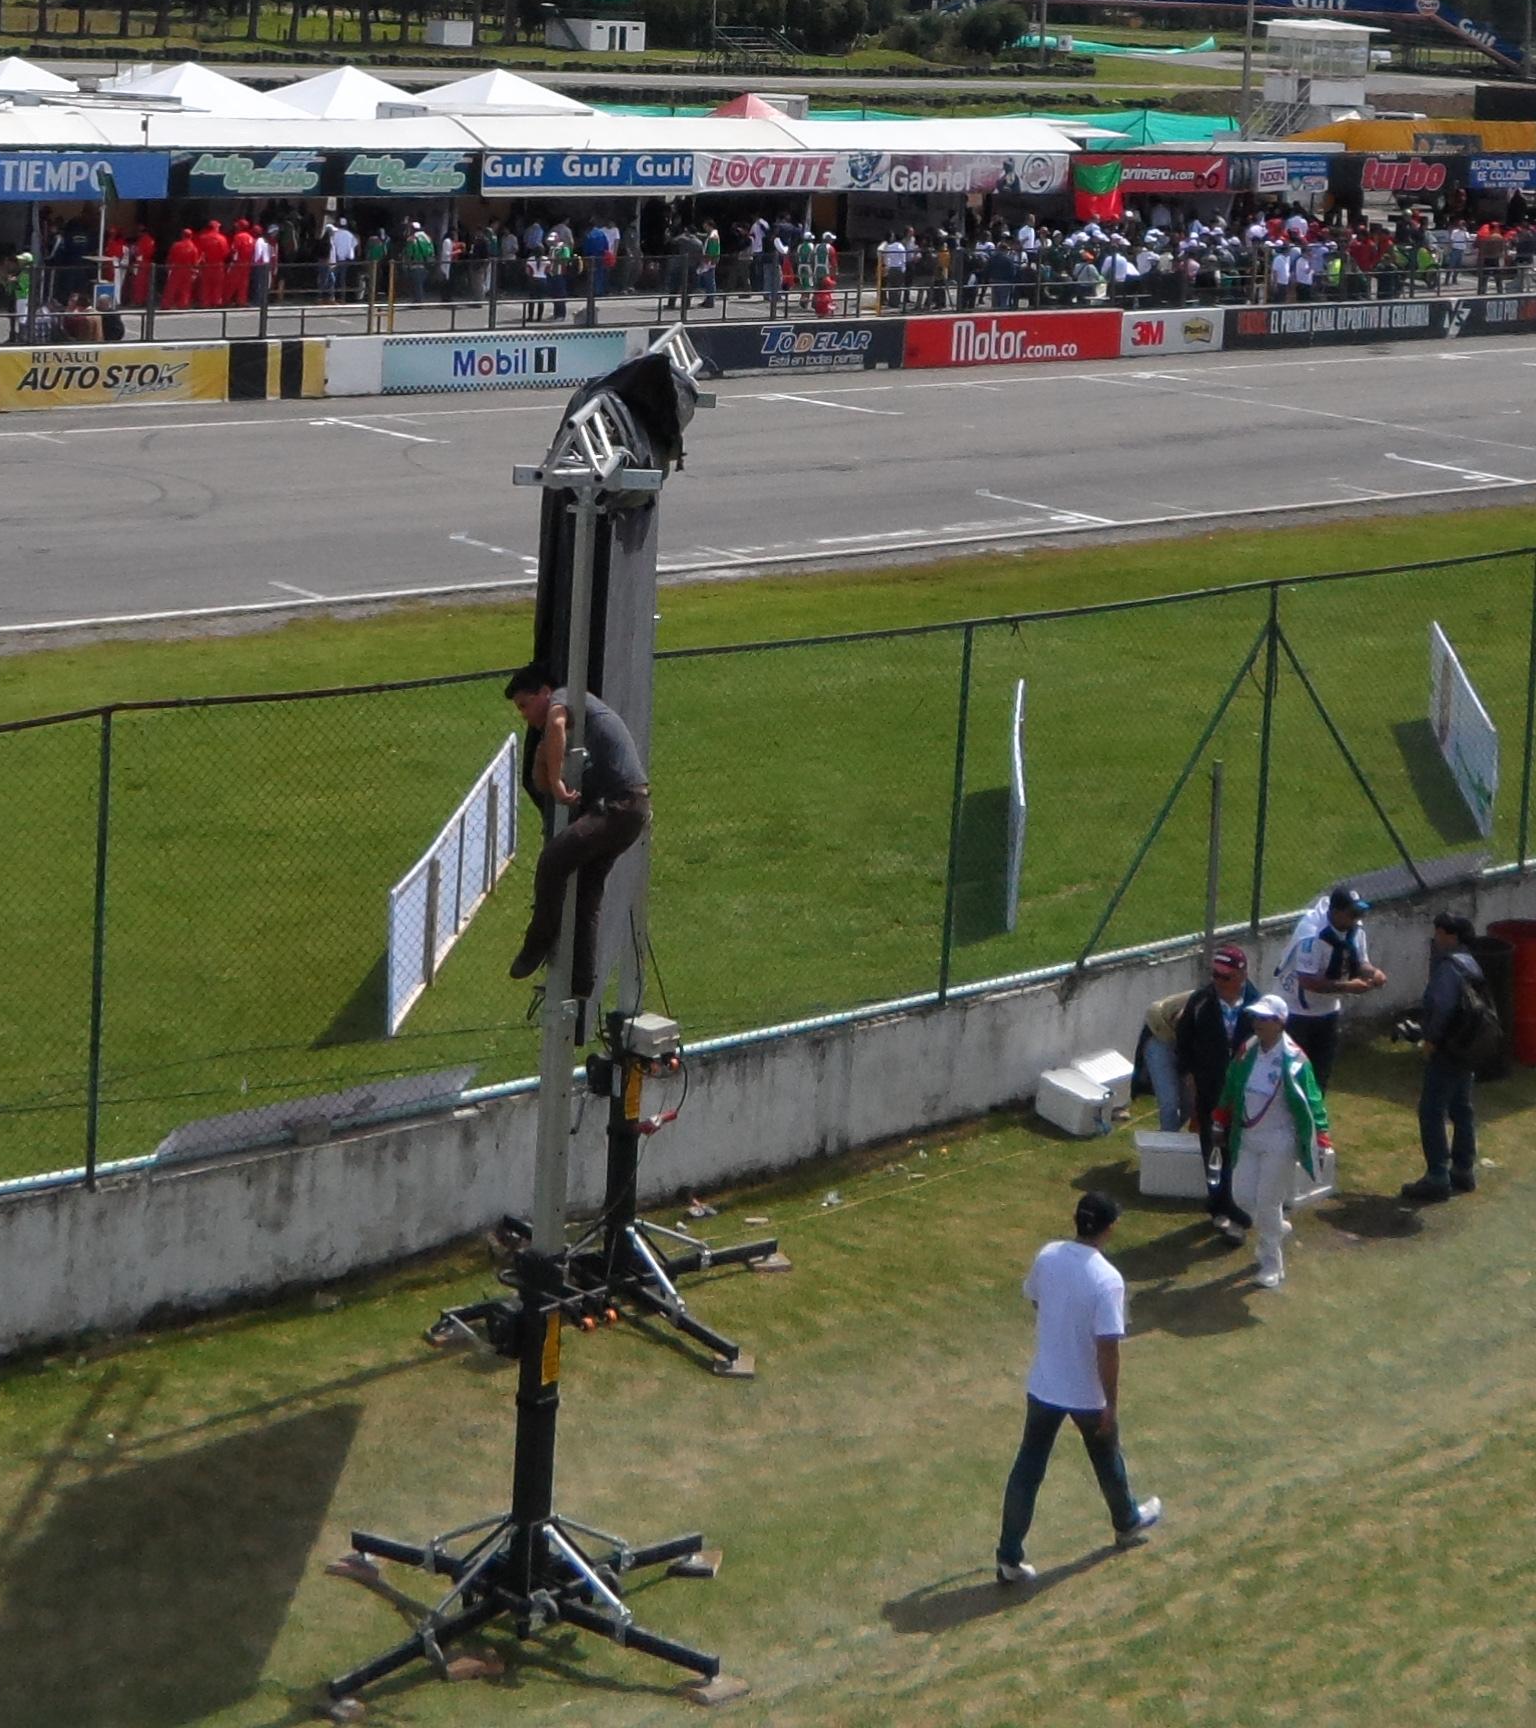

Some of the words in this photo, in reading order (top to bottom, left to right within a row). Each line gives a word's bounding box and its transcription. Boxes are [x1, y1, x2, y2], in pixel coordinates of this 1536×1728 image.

[1458, 17, 1497, 47] Gulf
[0, 159, 112, 193] TIEMPO
[484, 154, 545, 179] Gulf
[562, 154, 621, 179] Gulf
[635, 154, 693, 178] Gulf
[705, 154, 839, 188] LOCTITE
[889, 164, 971, 193] Gabriel
[1361, 156, 1447, 192] turbo
[1470, 158, 1515, 170] AUTOMOVIL
[1517, 158, 1536, 170] CLUB
[1477, 170, 1488, 182] DE
[1489, 170, 1531, 181] COLOMBIA
[760, 324, 872, 354] TODELAR
[951, 319, 1078, 362] Motor.com.co
[1131, 320, 1164, 347] 3M
[30, 350, 101, 364] RENAULT
[452, 347, 527, 377] Mobil
